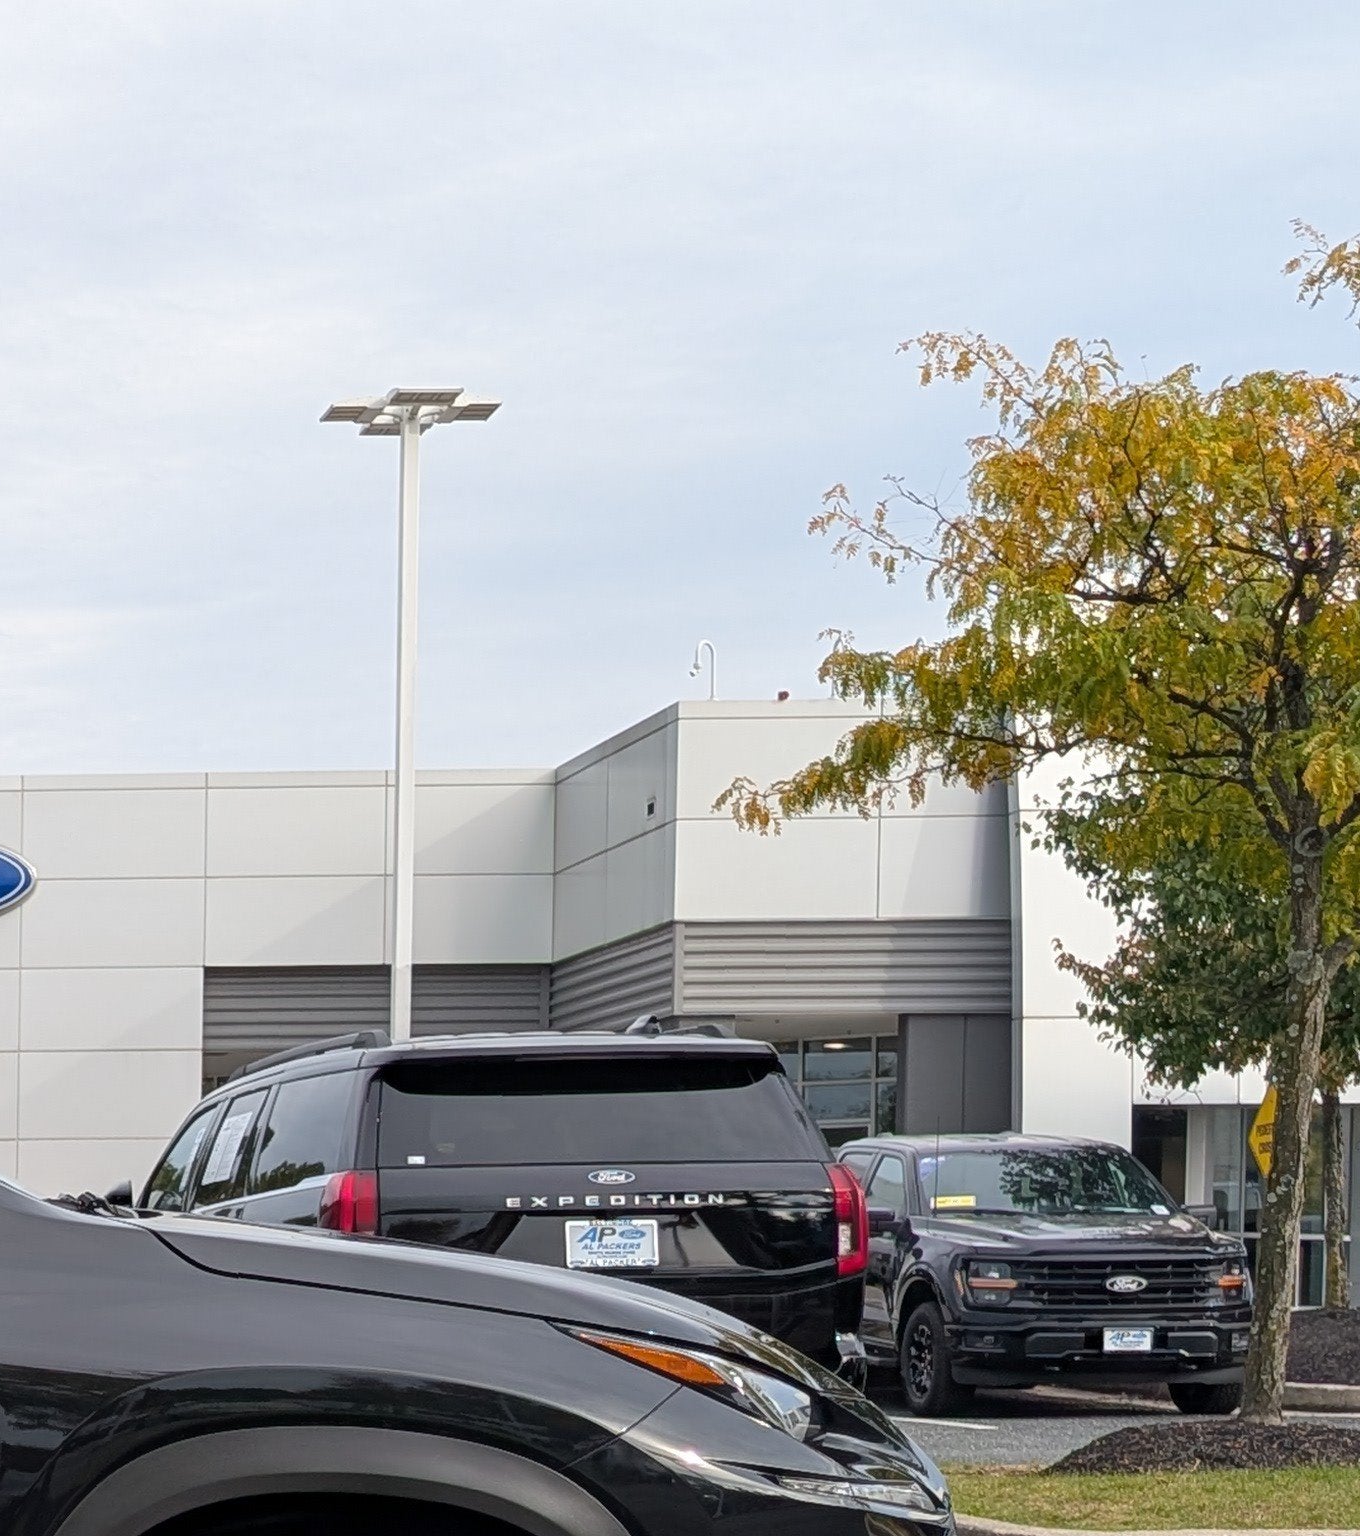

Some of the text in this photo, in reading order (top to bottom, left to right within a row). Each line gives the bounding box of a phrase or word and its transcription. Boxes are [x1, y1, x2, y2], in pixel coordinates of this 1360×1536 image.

[505, 1193, 724, 1208] EXPEDITION
[577, 1226, 617, 1243] AP
[597, 1242, 641, 1250] PACKERS
